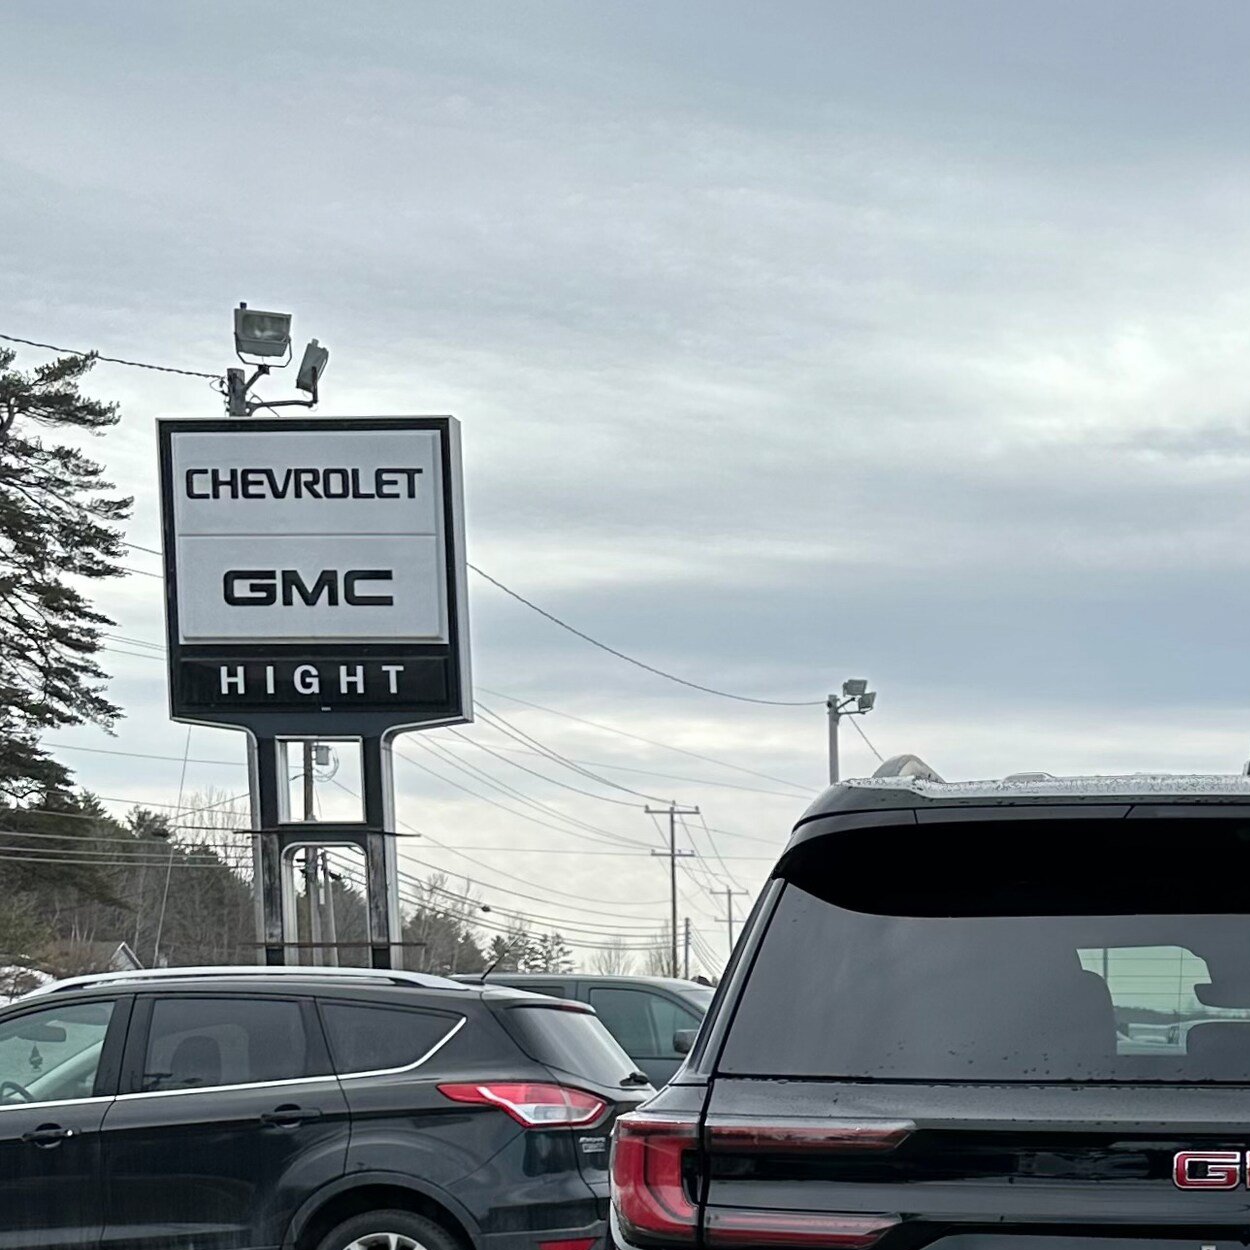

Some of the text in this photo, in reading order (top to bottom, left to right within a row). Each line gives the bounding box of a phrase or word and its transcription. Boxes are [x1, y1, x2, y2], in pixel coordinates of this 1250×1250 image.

[185, 468, 423, 499] CHEVROLET
[223, 569, 394, 607] GMC
[219, 665, 404, 695] HIGHT
